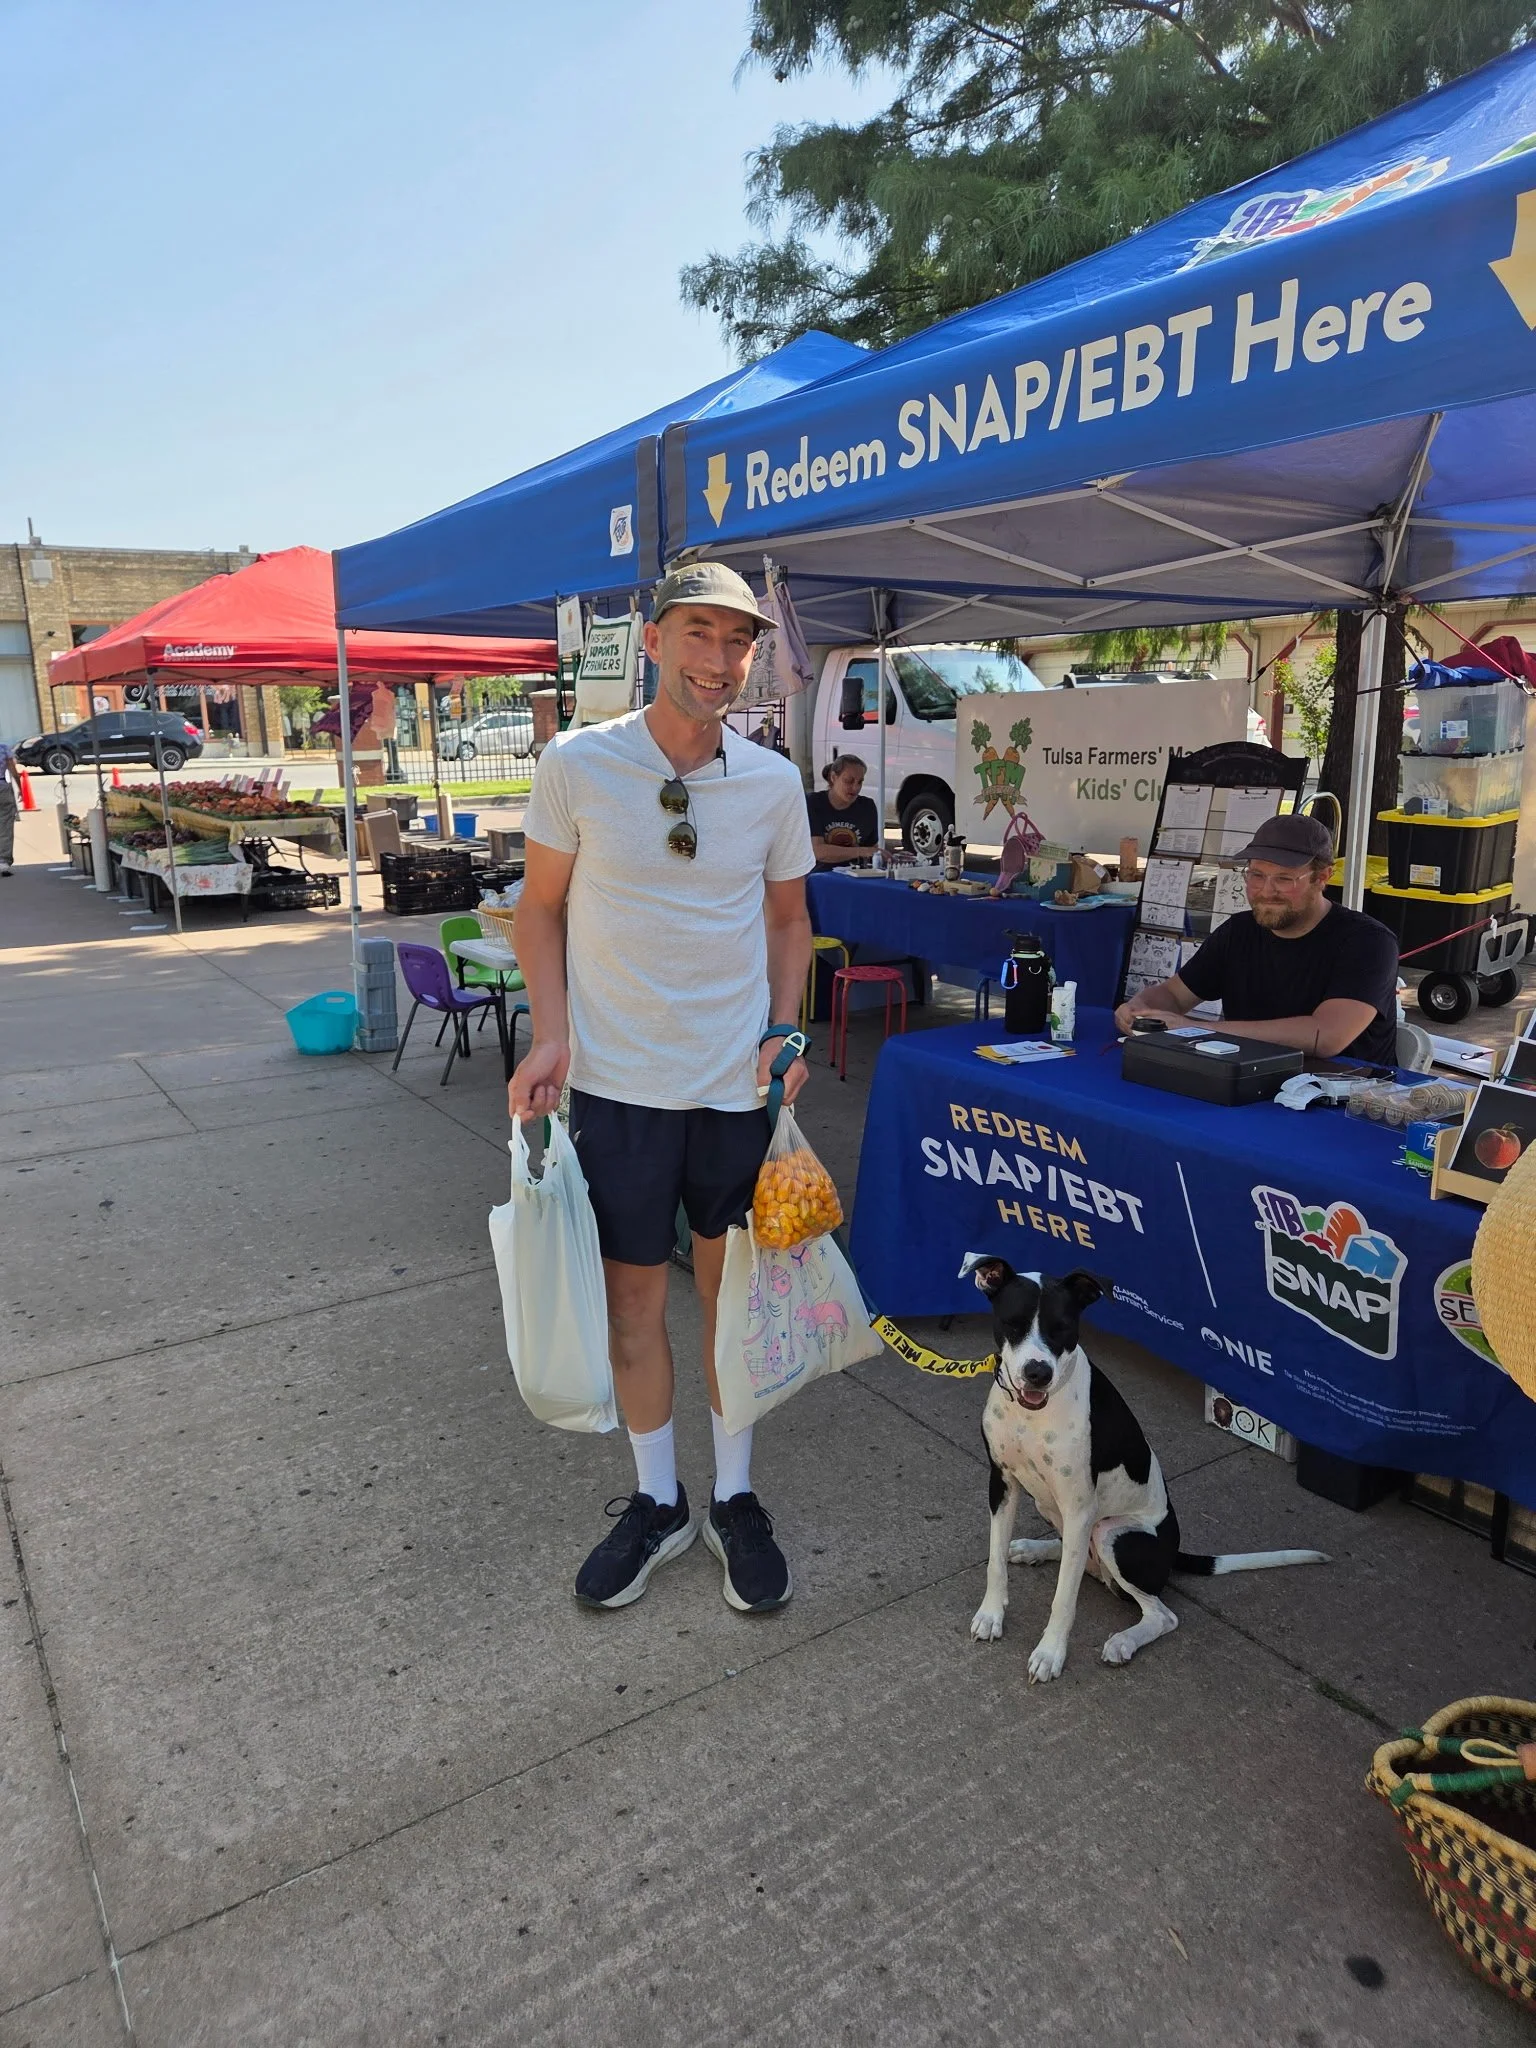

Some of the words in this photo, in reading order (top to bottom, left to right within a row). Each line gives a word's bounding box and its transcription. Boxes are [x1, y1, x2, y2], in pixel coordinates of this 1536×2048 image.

[746, 435, 886, 510] Redeem
[898, 305, 1213, 469] SNAP/EBT
[1230, 277, 1432, 384] Here
[163, 643, 235, 657] Academy
[1043, 747, 1083, 765] Tulsa
[1088, 746, 1162, 765] Farmers'
[973, 759, 1026, 790] TFM
[1076, 778, 1127, 800] Kids'
[949, 1103, 1088, 1165] REDEEM
[920, 1136, 1145, 1234] SNAP/EBT
[997, 1199, 1096, 1250] HERE
[1272, 1256, 1391, 1323] SNAP
[1143, 1306, 1185, 1331] Services
[923, 1360, 980, 1374] ADOPT
[1235, 1410, 1271, 1444] OK
